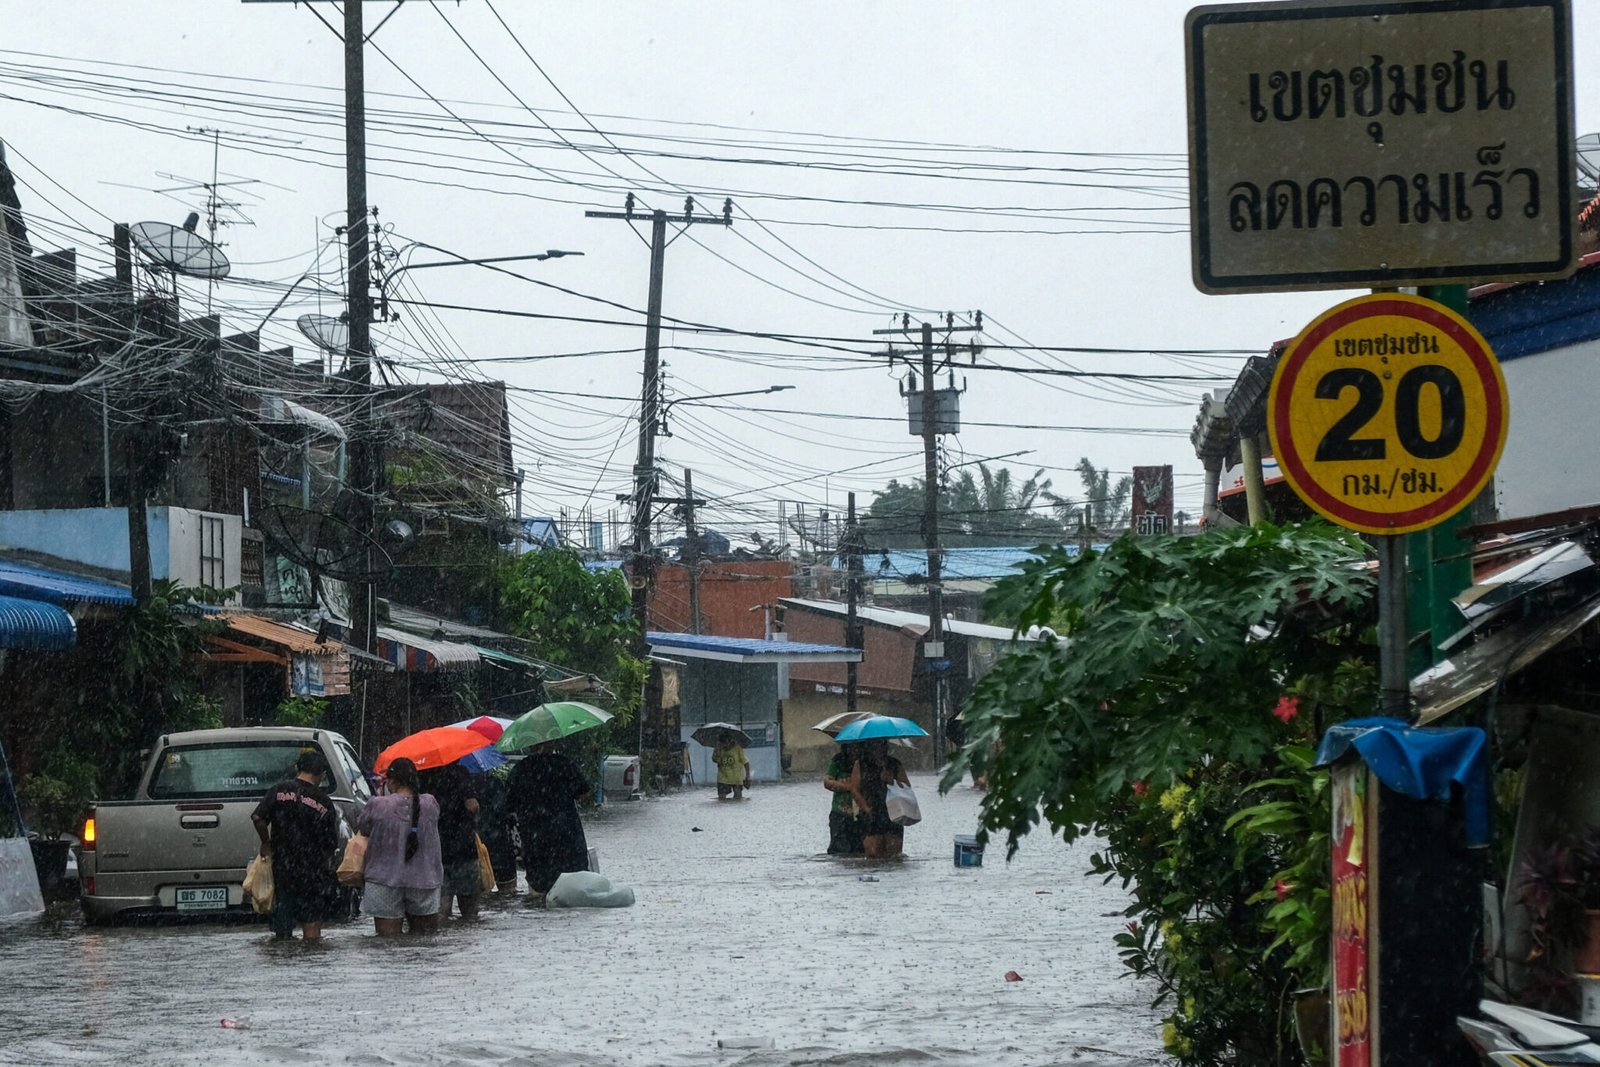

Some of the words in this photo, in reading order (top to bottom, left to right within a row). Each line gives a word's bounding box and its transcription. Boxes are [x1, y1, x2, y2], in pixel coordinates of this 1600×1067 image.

[1248, 51, 1515, 143] เขตชุมชน
[1227, 141, 1540, 232] ลดความเร็ว
[1334, 332, 1440, 364] เขตชุมชน
[1314, 364, 1466, 462] 20
[1342, 467, 1444, 499] กม./ชม.
[200, 889, 225, 900] 7082
